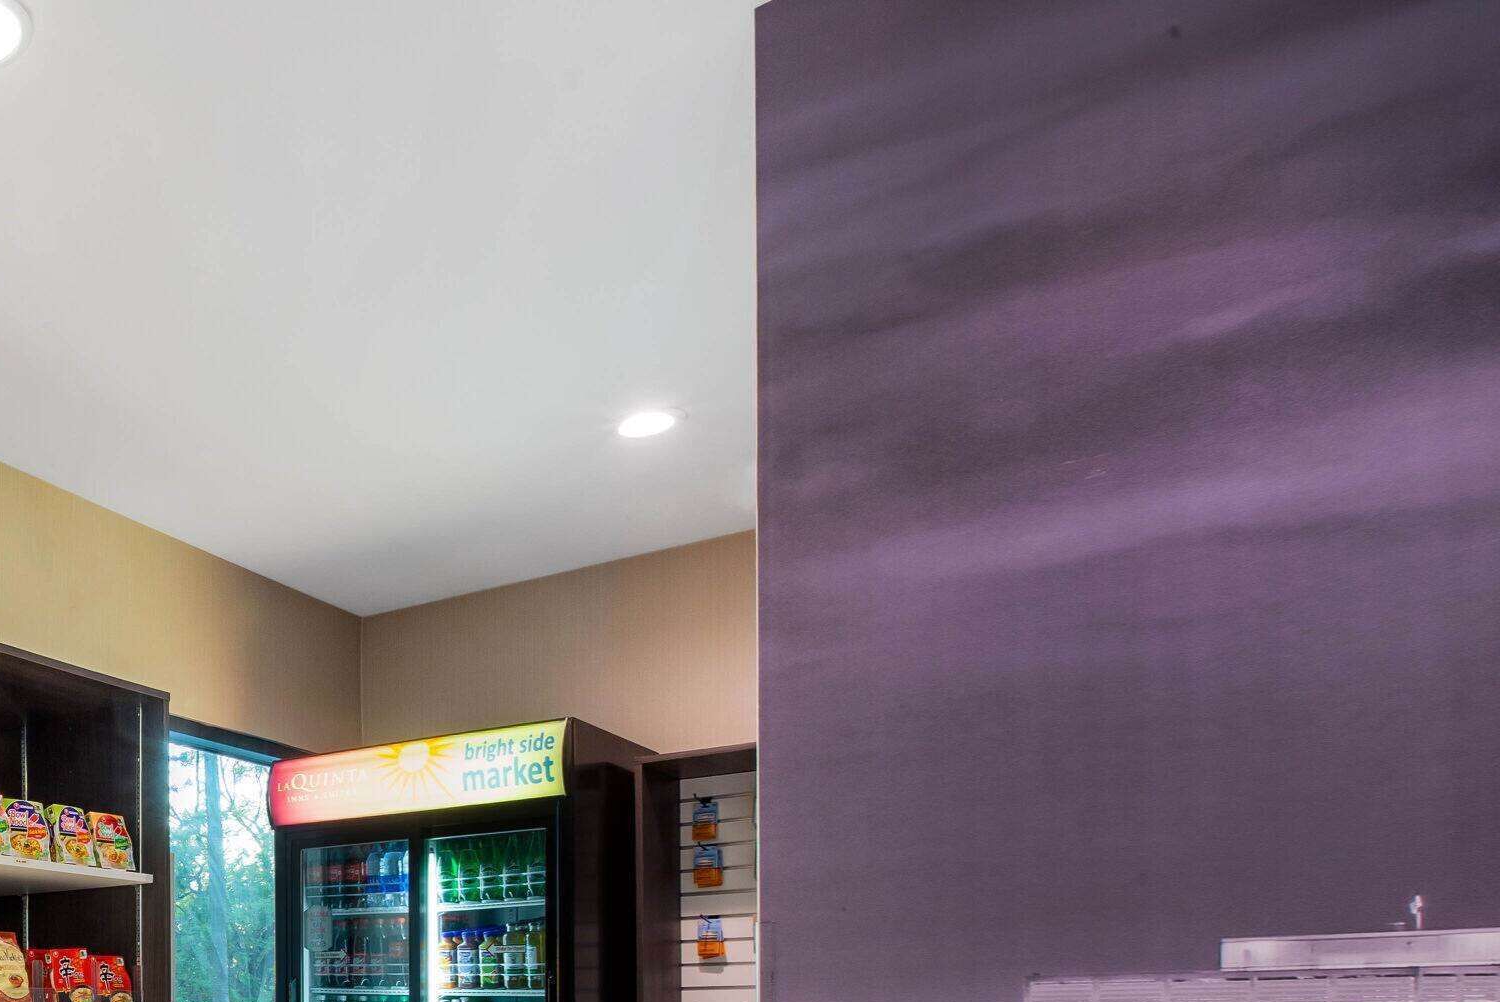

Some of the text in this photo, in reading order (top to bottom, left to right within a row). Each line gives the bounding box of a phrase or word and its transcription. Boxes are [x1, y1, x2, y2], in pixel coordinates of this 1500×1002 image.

[465, 732, 554, 761] bright side
[291, 767, 368, 792] QUINTA
[462, 756, 555, 791] market
